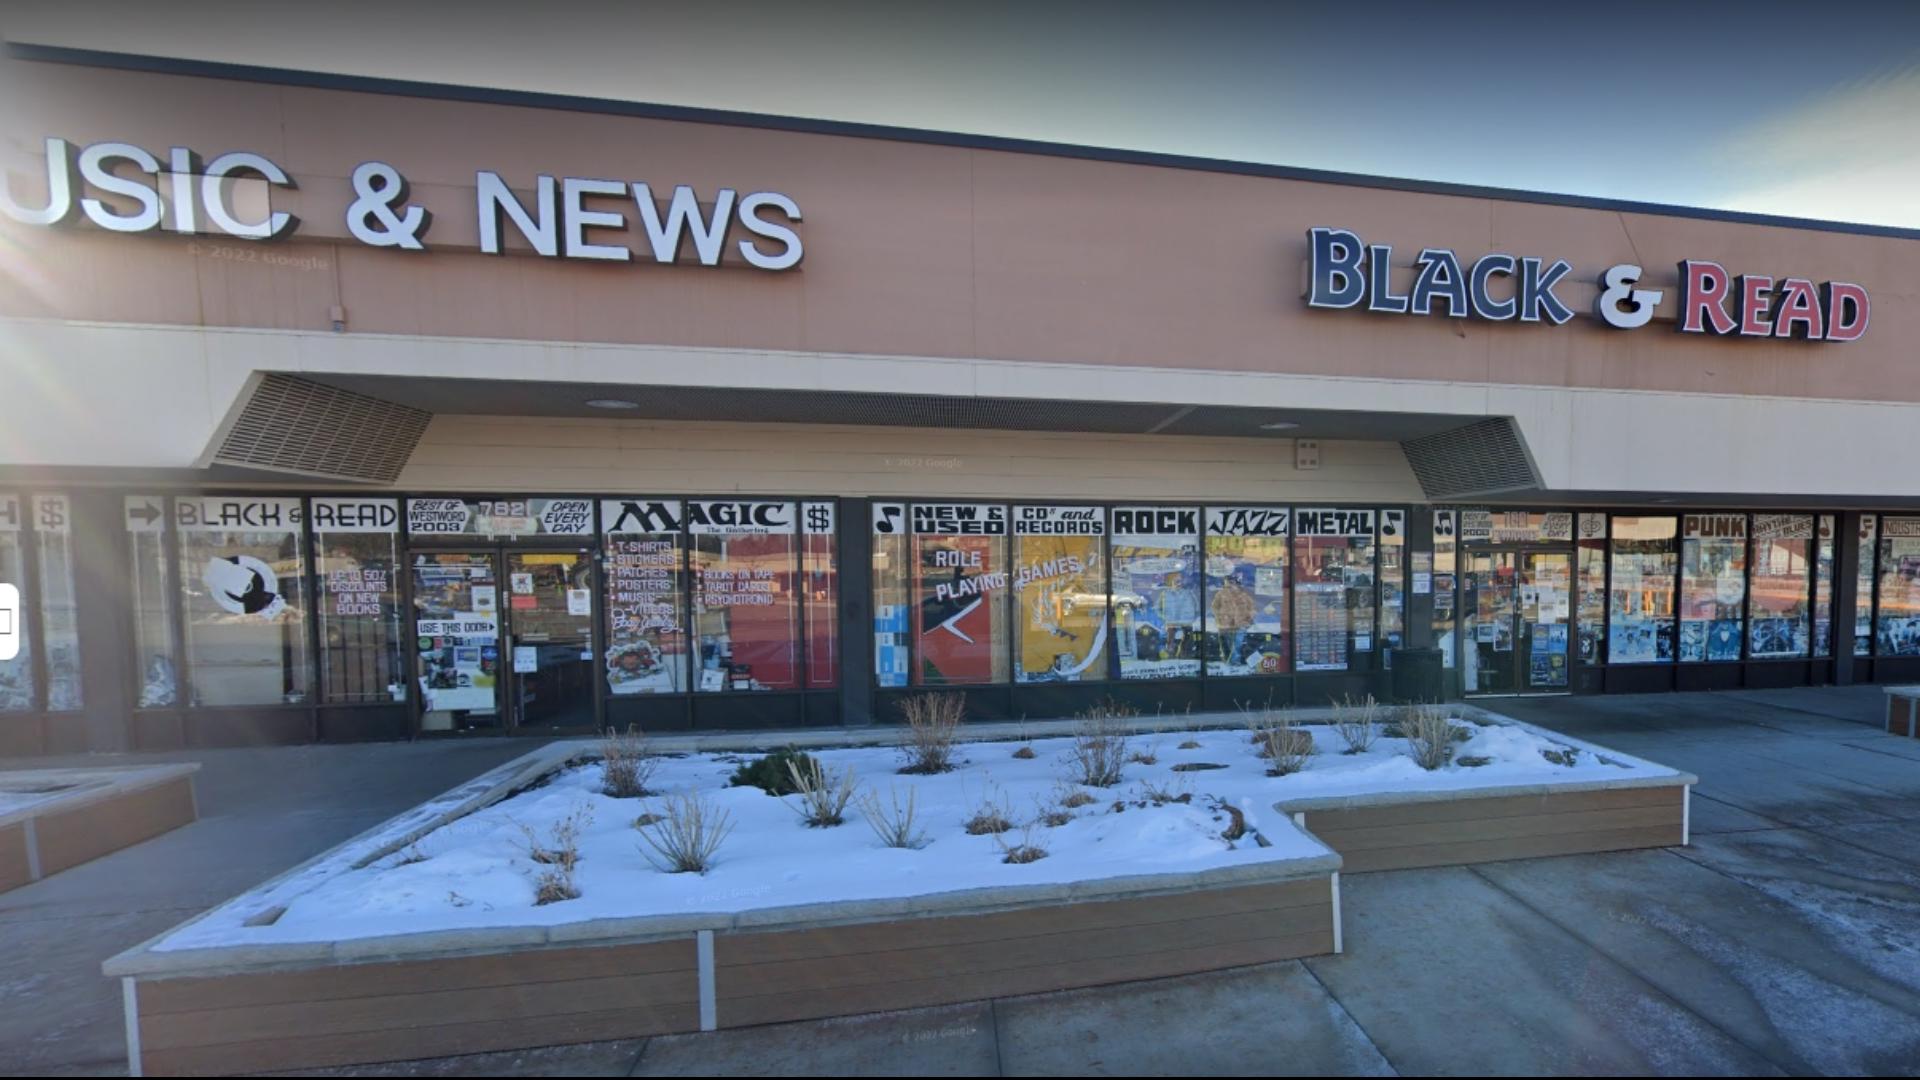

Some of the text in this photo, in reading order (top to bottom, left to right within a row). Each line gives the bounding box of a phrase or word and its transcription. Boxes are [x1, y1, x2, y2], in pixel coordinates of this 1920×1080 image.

[346, 161, 428, 249] &
[477, 170, 805, 271] NEWS
[1308, 227, 1870, 342] BLACK & READ
[413, 501, 460, 510] BEST OF
[551, 501, 590, 512] OPEN
[177, 503, 280, 526] BLACK
[315, 504, 397, 527] READ
[409, 511, 466, 521] WESTWORD
[544, 513, 590, 523] EVERY
[608, 501, 789, 532] MAGIC
[914, 506, 1004, 520] NEW &
[1061, 508, 1096, 520] and
[411, 522, 460, 531] 2003
[552, 524, 585, 533] DAY
[915, 520, 1005, 533] USED
[1016, 521, 1102, 533] RECORDS
[1114, 511, 1197, 534] ROCK
[1208, 509, 1289, 537] JAZZ
[1297, 512, 1374, 534] METAL
[1685, 517, 1744, 537] PUNK
[617, 541, 672, 552] T-SHIRTS
[617, 554, 674, 565] STICKERS
[936, 550, 983, 567] ROLE
[364, 569, 386, 581] 50%
[617, 567, 668, 577] PATCHES
[704, 570, 775, 579] BOOKS ON TAPE
[936, 572, 1006, 601] PLAYING
[1020, 556, 1081, 583] GAMES
[330, 581, 388, 592] DISCOUNTS
[617, 580, 671, 590] POSTERS
[705, 582, 769, 592] TAROT CARDS
[338, 592, 380, 603] ON NEW
[336, 603, 381, 615] BOOKS
[420, 622, 488, 634] USE THIS DOOR
